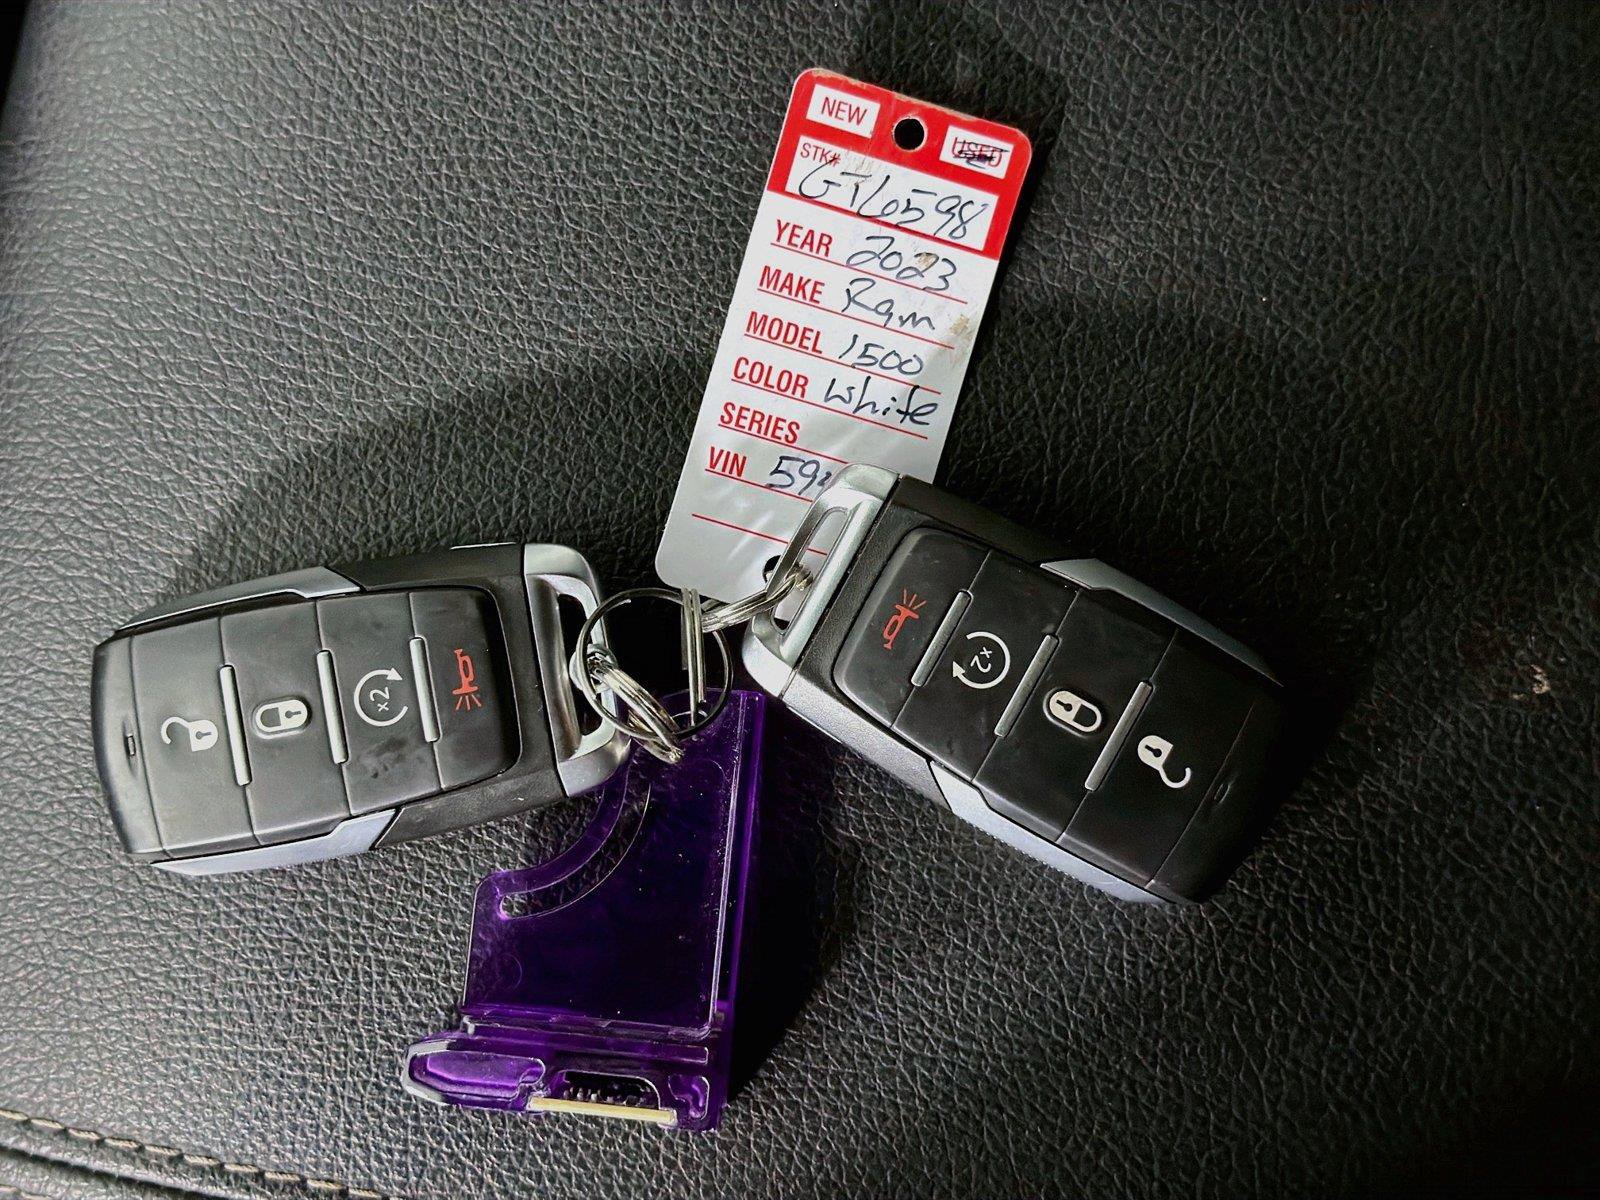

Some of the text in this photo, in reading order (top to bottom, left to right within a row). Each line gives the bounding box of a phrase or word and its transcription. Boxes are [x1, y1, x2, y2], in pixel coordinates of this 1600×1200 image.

[821, 97, 867, 126] NEW
[800, 142, 841, 167] STK#
[775, 219, 834, 258] YEAR
[758, 265, 826, 304] MAKE
[846, 236, 957, 291] 2023
[840, 277, 935, 328] Ram
[745, 310, 823, 354] MODEL
[838, 333, 924, 376] 1500
[733, 356, 810, 399] COLOR
[719, 401, 801, 444] SERIES
[708, 446, 747, 478] VIN
